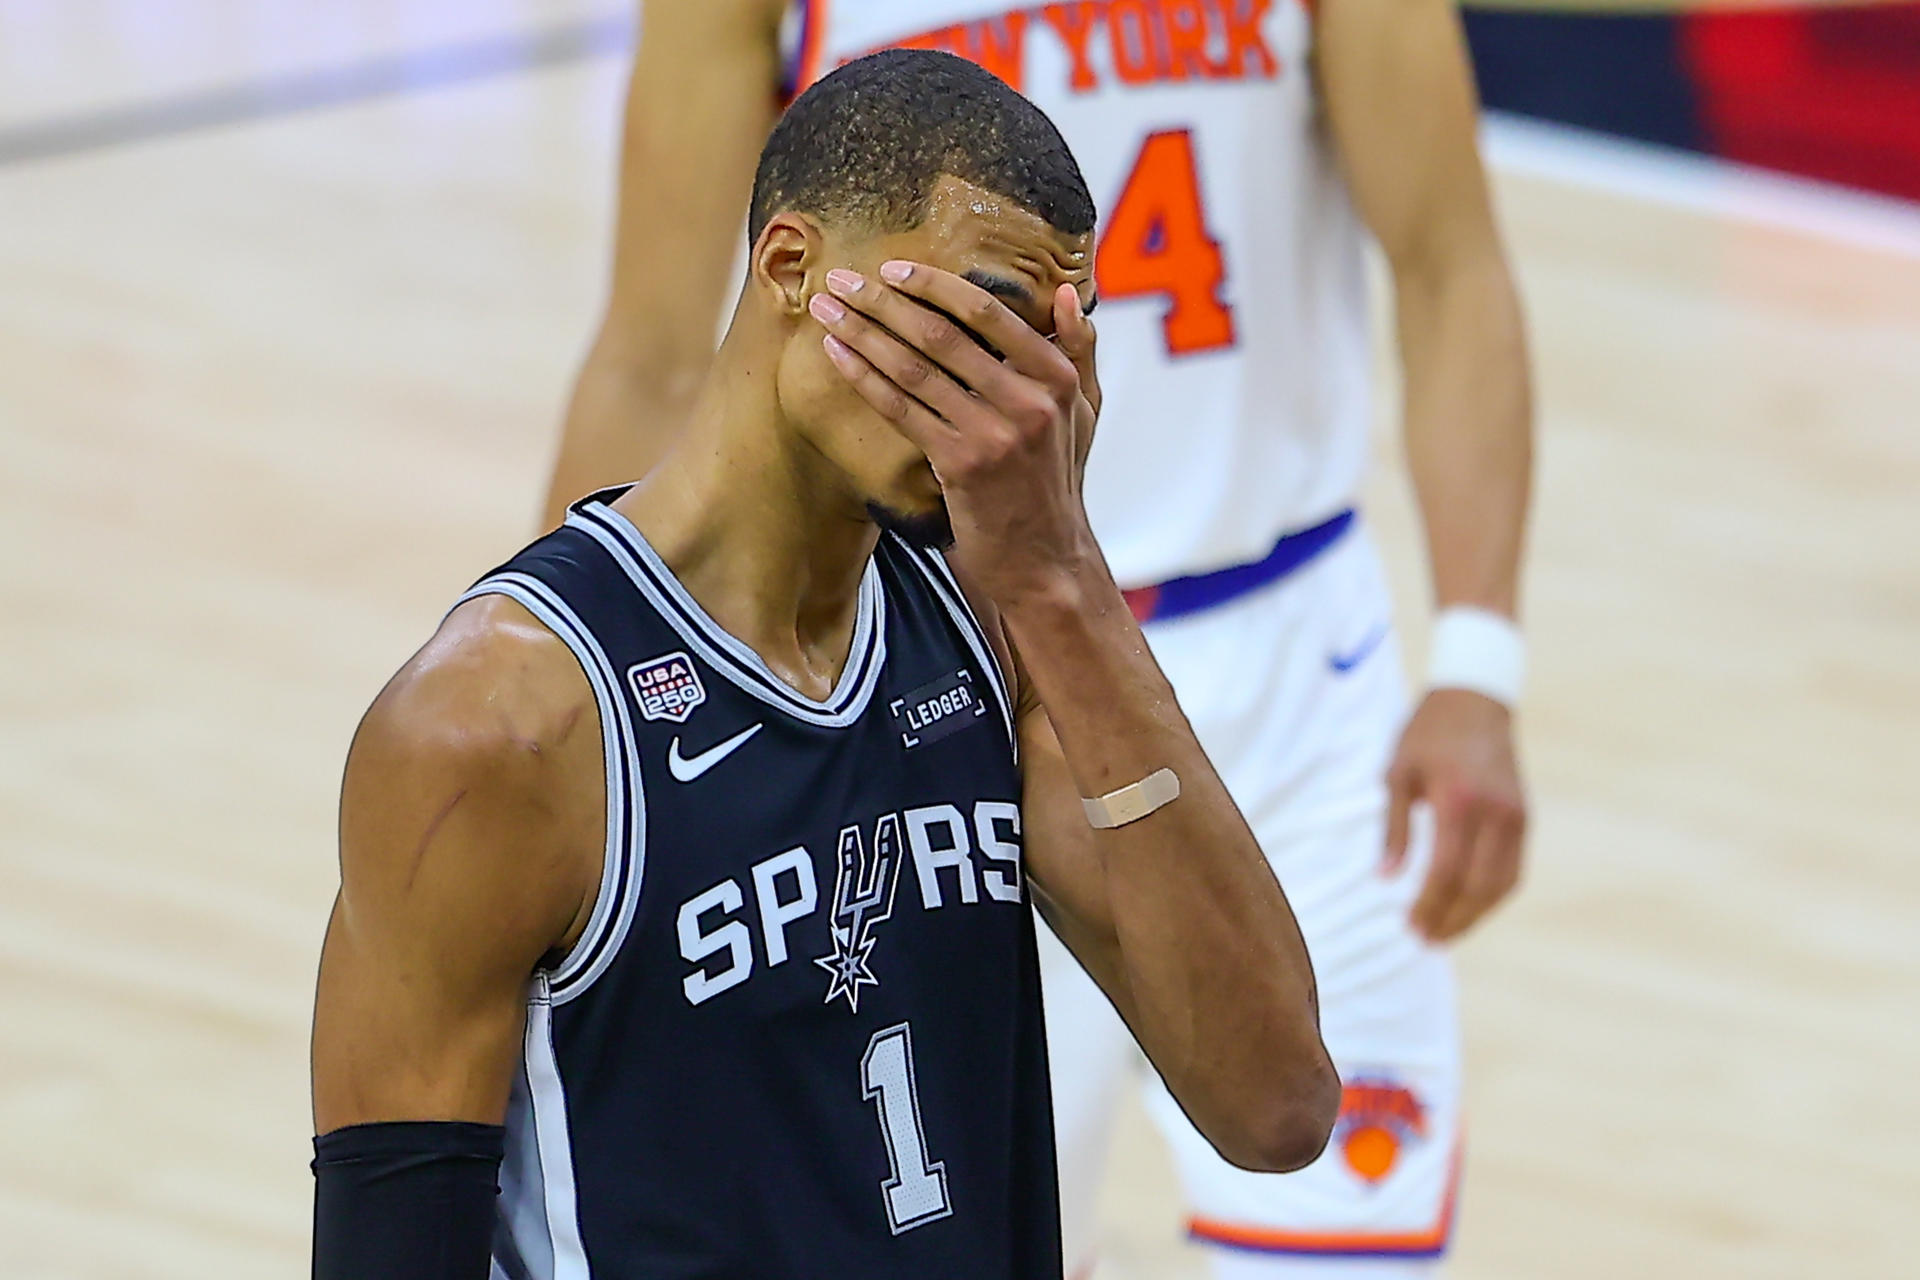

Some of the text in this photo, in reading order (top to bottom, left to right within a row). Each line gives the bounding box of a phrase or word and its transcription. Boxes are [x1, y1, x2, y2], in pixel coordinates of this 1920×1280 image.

[1043, 0, 1278, 92] YORK
[637, 663, 687, 688] USA
[644, 684, 700, 714] 250
[906, 685, 972, 730] LEDGER
[676, 800, 1022, 1013] SPURS
[861, 1021, 953, 1236] 1
